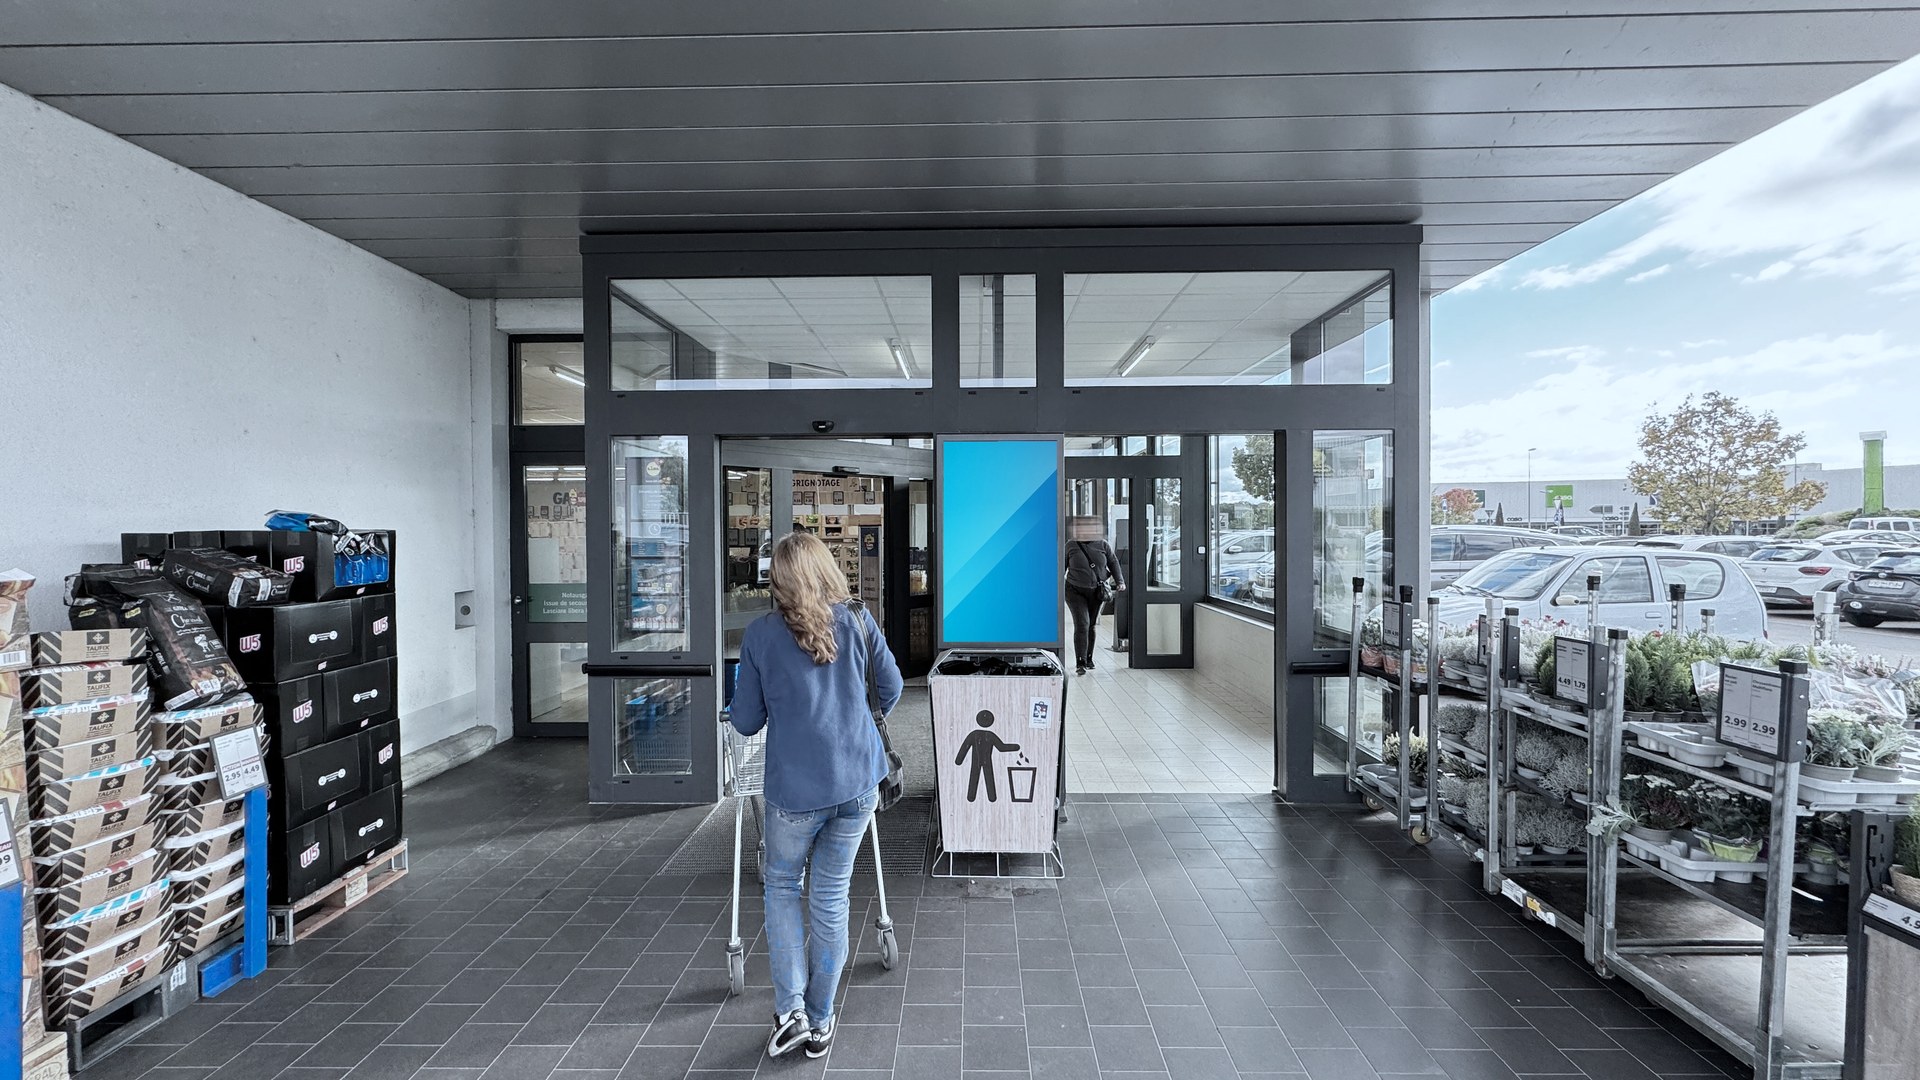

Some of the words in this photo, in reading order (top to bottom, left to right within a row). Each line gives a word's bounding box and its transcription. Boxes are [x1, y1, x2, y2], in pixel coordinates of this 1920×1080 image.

[792, 479, 840, 487] GRIGNOTAGE
[283, 556, 304, 574] W5
[372, 616, 388, 636] W5
[239, 634, 261, 653] W5
[1574, 680, 1586, 689] 1.79
[292, 700, 313, 723] W5
[89, 723, 114, 731] TAUFIX
[1724, 715, 1747, 728] 2.99
[1752, 722, 1776, 735] 2.99
[91, 753, 115, 763] TAUFIX
[378, 743, 393, 764] W5
[225, 771, 241, 782] 2.95
[244, 764, 260, 775] 4.49
[97, 788, 122, 798] TAUFIX
[100, 822, 124, 832] TAUFIX
[300, 842, 320, 868] W5
[107, 882, 131, 893] TAUFIX
